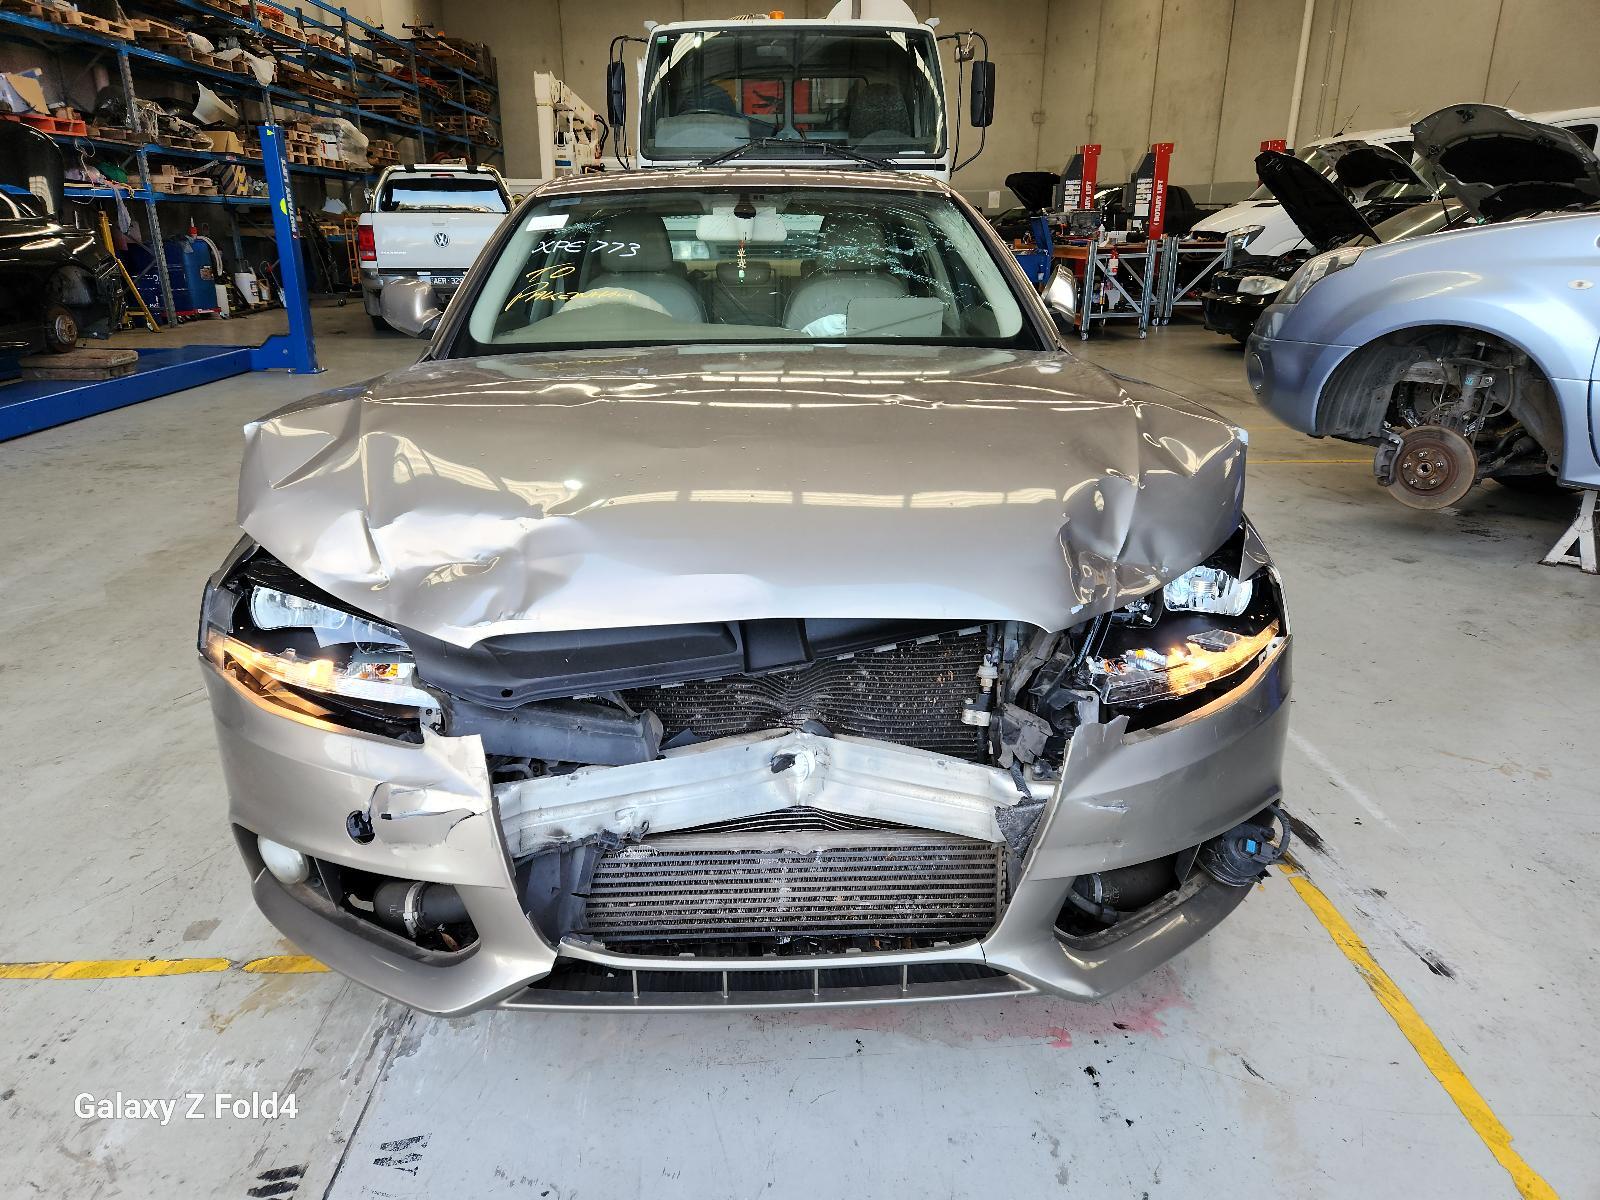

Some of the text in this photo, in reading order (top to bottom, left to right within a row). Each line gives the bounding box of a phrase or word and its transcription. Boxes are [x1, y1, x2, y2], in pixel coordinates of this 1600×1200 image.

[1154, 195, 1162, 222] ROTARY
[531, 240, 640, 257] XPE 773
